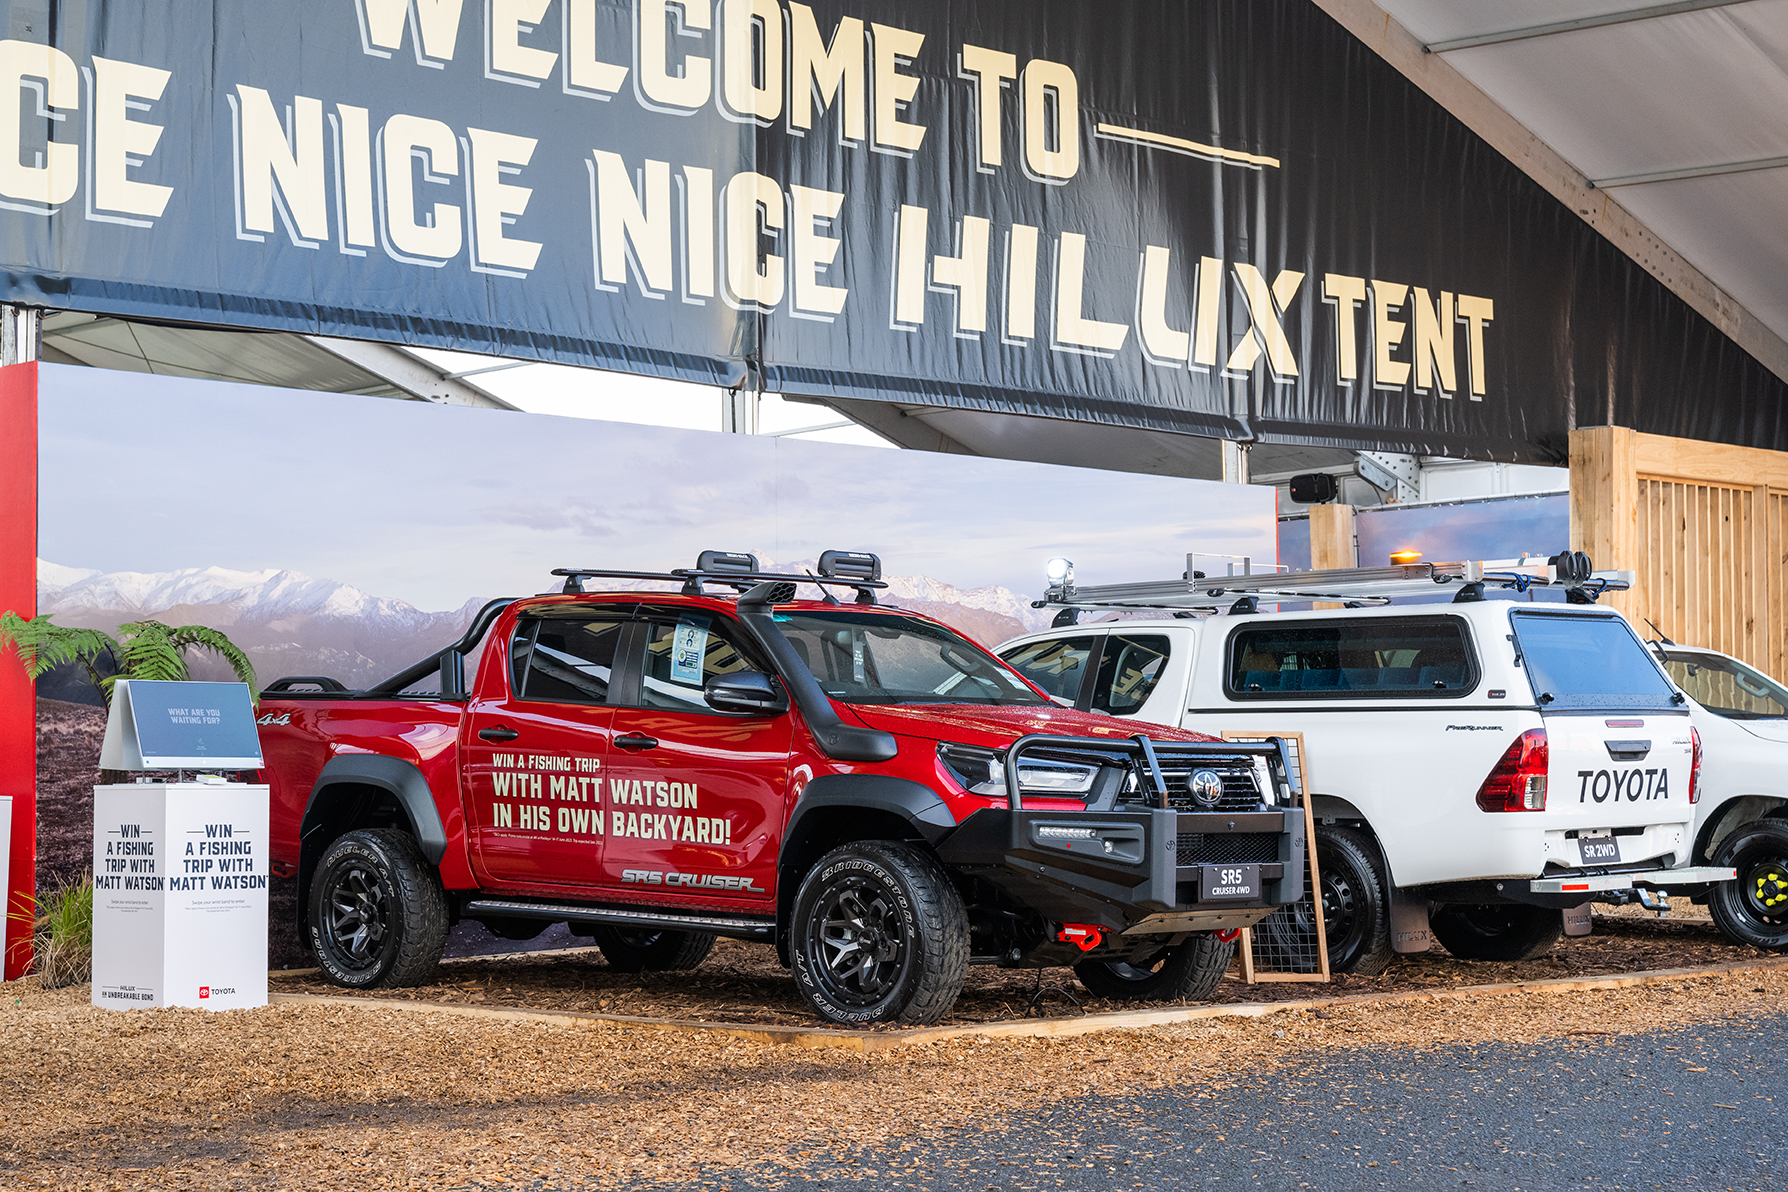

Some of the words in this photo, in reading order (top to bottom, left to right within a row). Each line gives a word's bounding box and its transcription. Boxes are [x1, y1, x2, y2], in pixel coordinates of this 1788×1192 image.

[958, 44, 1079, 185] TO
[227, 84, 543, 279] NICE
[585, 148, 848, 323] NICE
[890, 204, 1305, 384] HILUX
[1321, 272, 1494, 401] TENT
[168, 708, 189, 716] WHAT
[191, 708, 205, 717] ARE
[206, 708, 220, 717] YOU
[171, 716, 201, 724] WAITING
[203, 716, 220, 724] FOR?
[492, 753, 514, 769] WIN
[517, 755, 525, 769] A
[528, 755, 571, 772] FISHING
[575, 757, 601, 774] TRIP
[492, 771, 543, 799] WITH
[549, 774, 603, 803] MATT
[609, 778, 698, 810] WATSON
[1577, 768, 1668, 803] TOYOTA
[120, 824, 140, 838] WIN
[205, 824, 232, 838] WIN
[492, 803, 512, 828] IN
[518, 804, 551, 832] HIS
[557, 807, 604, 835] OWN
[611, 811, 732, 846] BACKYARD!
[106, 841, 113, 855] A
[117, 841, 154, 856] FISHING
[185, 842, 194, 855] A
[200, 841, 251, 855] FISHING
[1584, 844, 1596, 858] SR
[1597, 843, 1616, 857] 2WD
[327, 846, 378, 867] DUELER
[105, 858, 126, 872] TRIP
[130, 859, 155, 873] WITH
[183, 859, 213, 873] TRIP
[219, 858, 253, 872] WITH
[95, 875, 121, 890] MATT
[169, 876, 206, 891] MATT
[620, 869, 663, 885] SR5
[664, 872, 765, 892] CRUISER
[1220, 869, 1242, 885] SR5
[1212, 887, 1236, 896] CRUISER
[1236, 885, 1250, 894] 4WD
[821, 860, 915, 938] BRIDGESTONE
[1567, 915, 1590, 926] HILUX
[1397, 930, 1427, 942] HILUX
[108, 991, 140, 1000] UNBREAKABLE
[211, 987, 236, 995] TOYOTA
